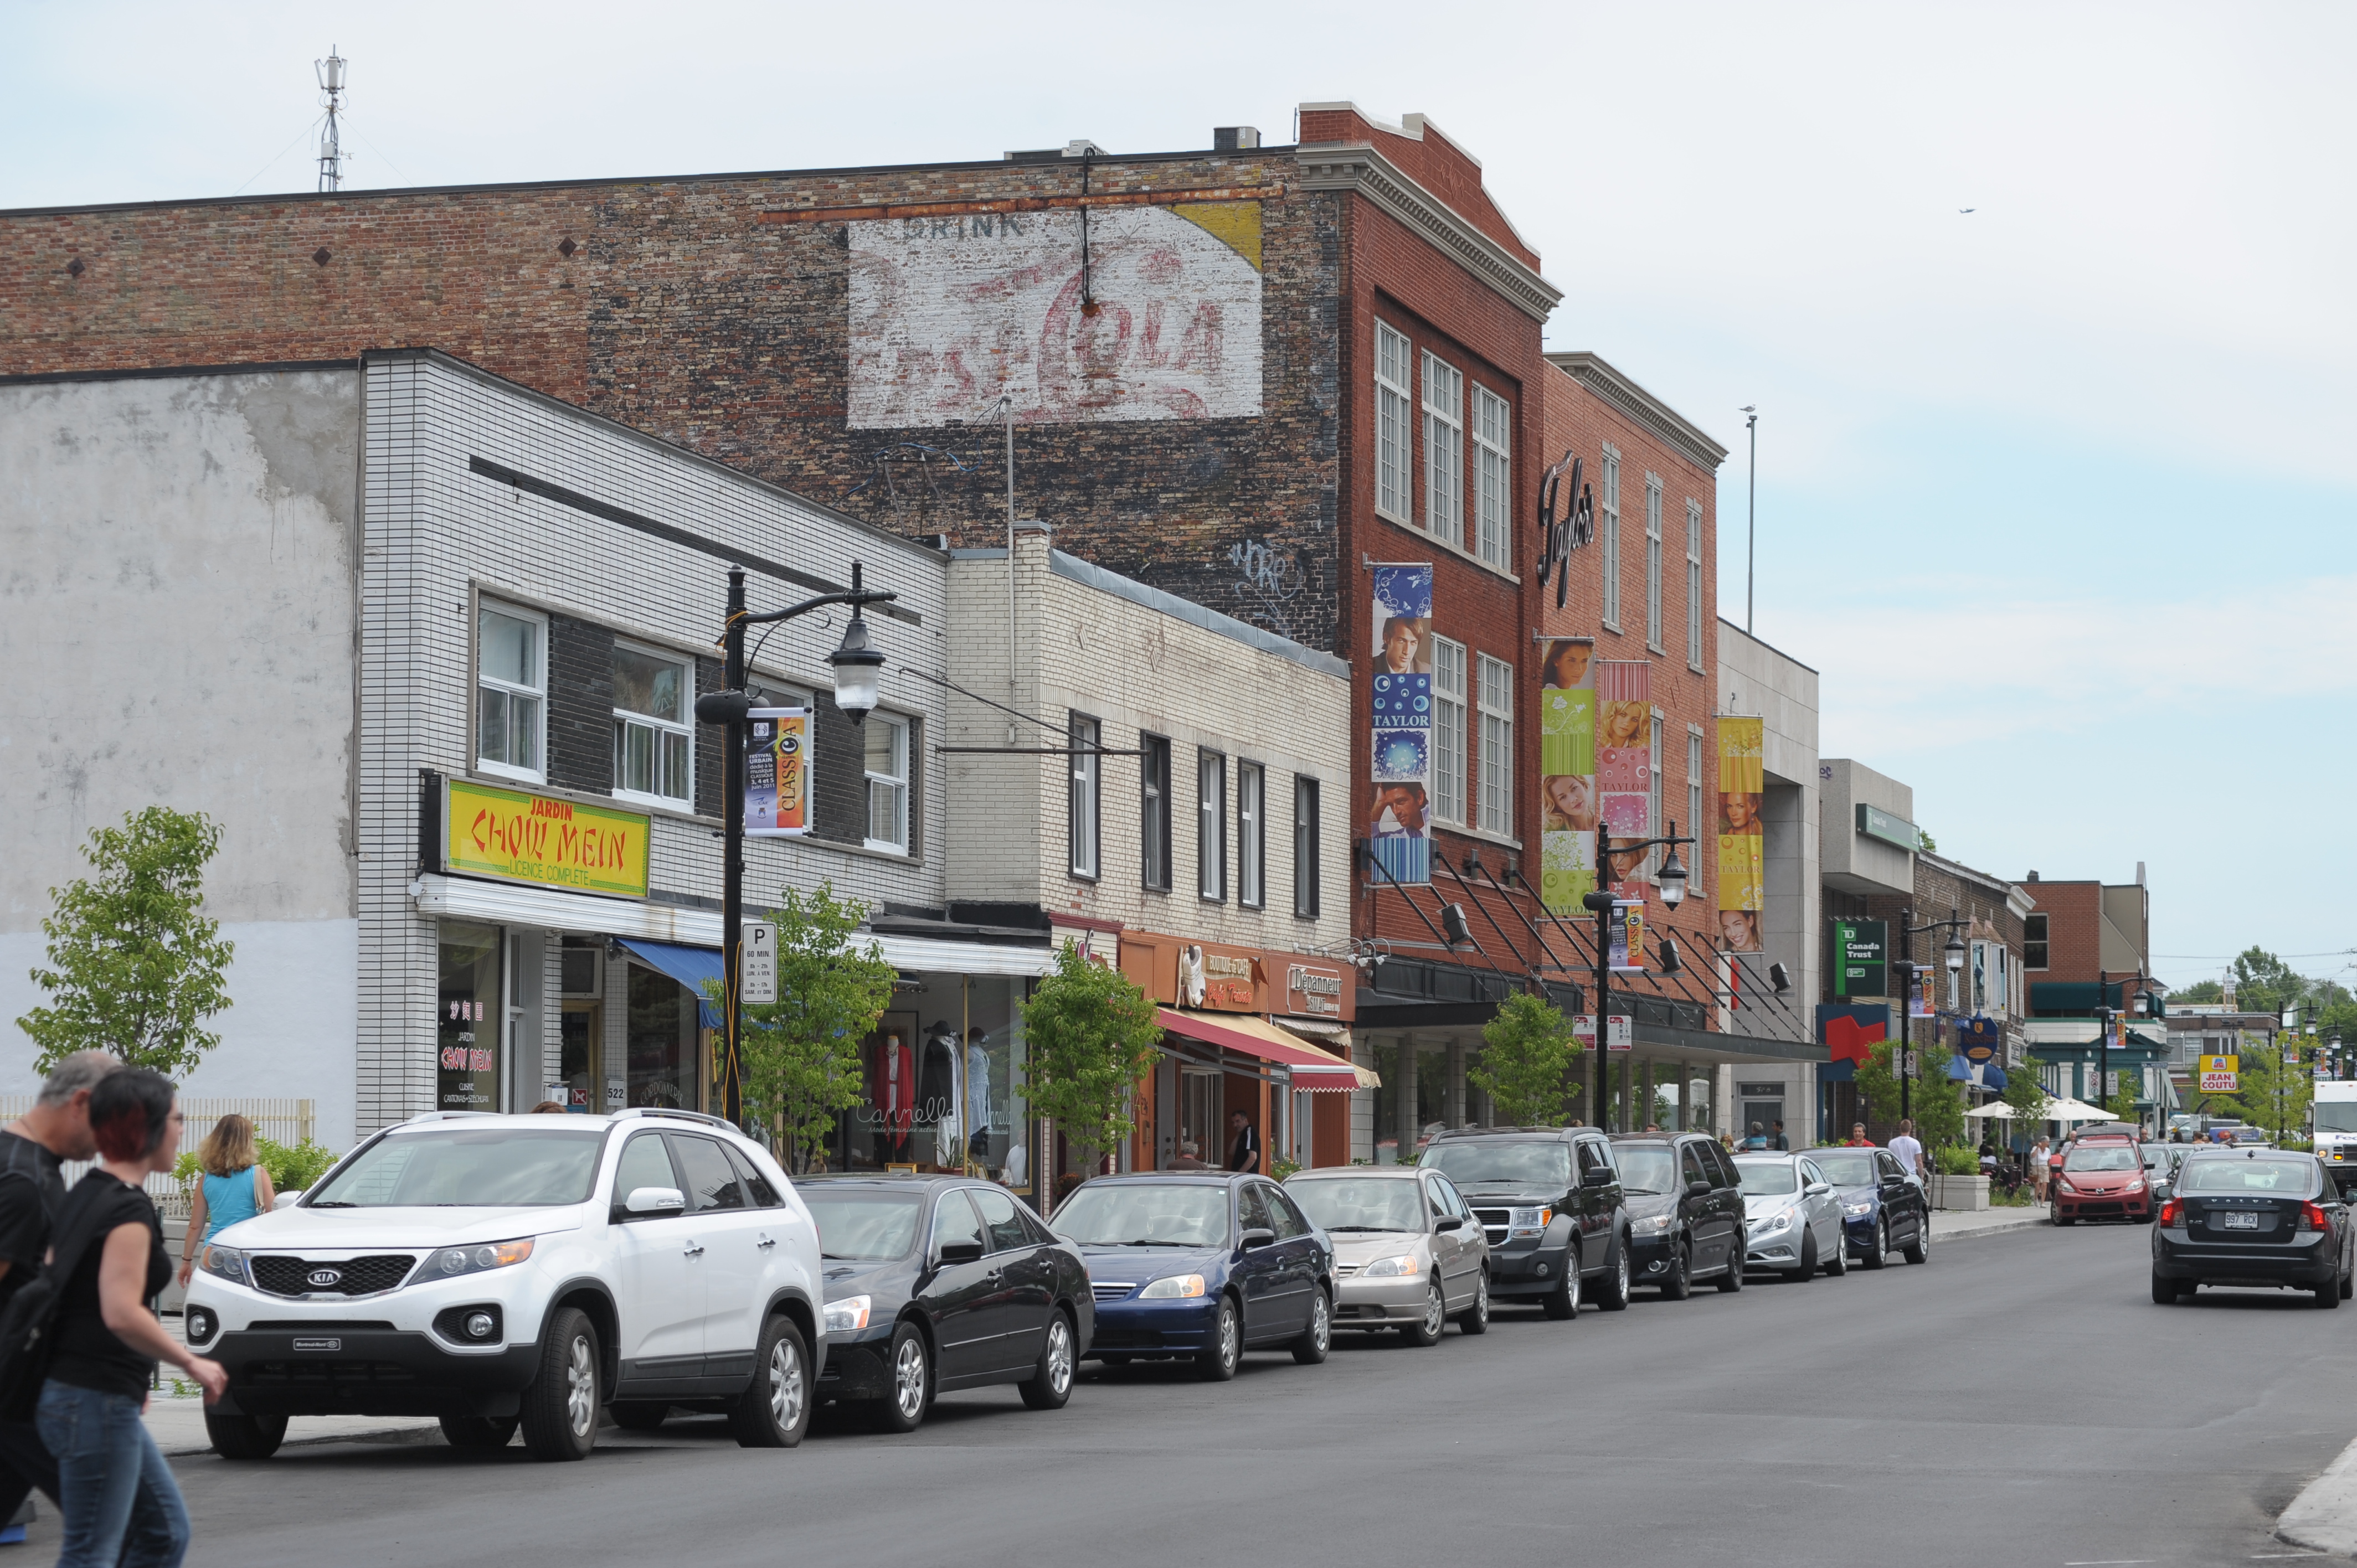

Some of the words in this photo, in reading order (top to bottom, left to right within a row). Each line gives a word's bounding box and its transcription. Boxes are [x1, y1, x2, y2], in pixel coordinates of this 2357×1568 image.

[903, 215, 1025, 240] DRINK
[1373, 715, 1429, 726] TAYLOR
[1602, 782, 1648, 791] TAYLOR
[530, 798, 573, 822] JARDIN
[471, 808, 547, 861] CHOW
[557, 823, 626, 872] MEIN
[509, 859, 543, 879] LICENCE
[754, 929, 765, 944] P
[1843, 930, 1855, 938] TD
[1208, 955, 1231, 972] BOUTIQUE
[1293, 968, 1342, 996] Dépanneur
[458, 1032, 475, 1041] JARDIN
[441, 1046, 467, 1070] CHOW
[470, 1046, 492, 1072] MEIN
[608, 1088, 624, 1098] 522
[640, 1081, 684, 1106] CORDONNERIE
[856, 1097, 961, 1123] Cannelle
[886, 1125, 917, 1136] féminine
[2226, 1215, 2239, 1224] 997
[2244, 1216, 2257, 1224] RCK
[314, 1273, 333, 1282] KIA
